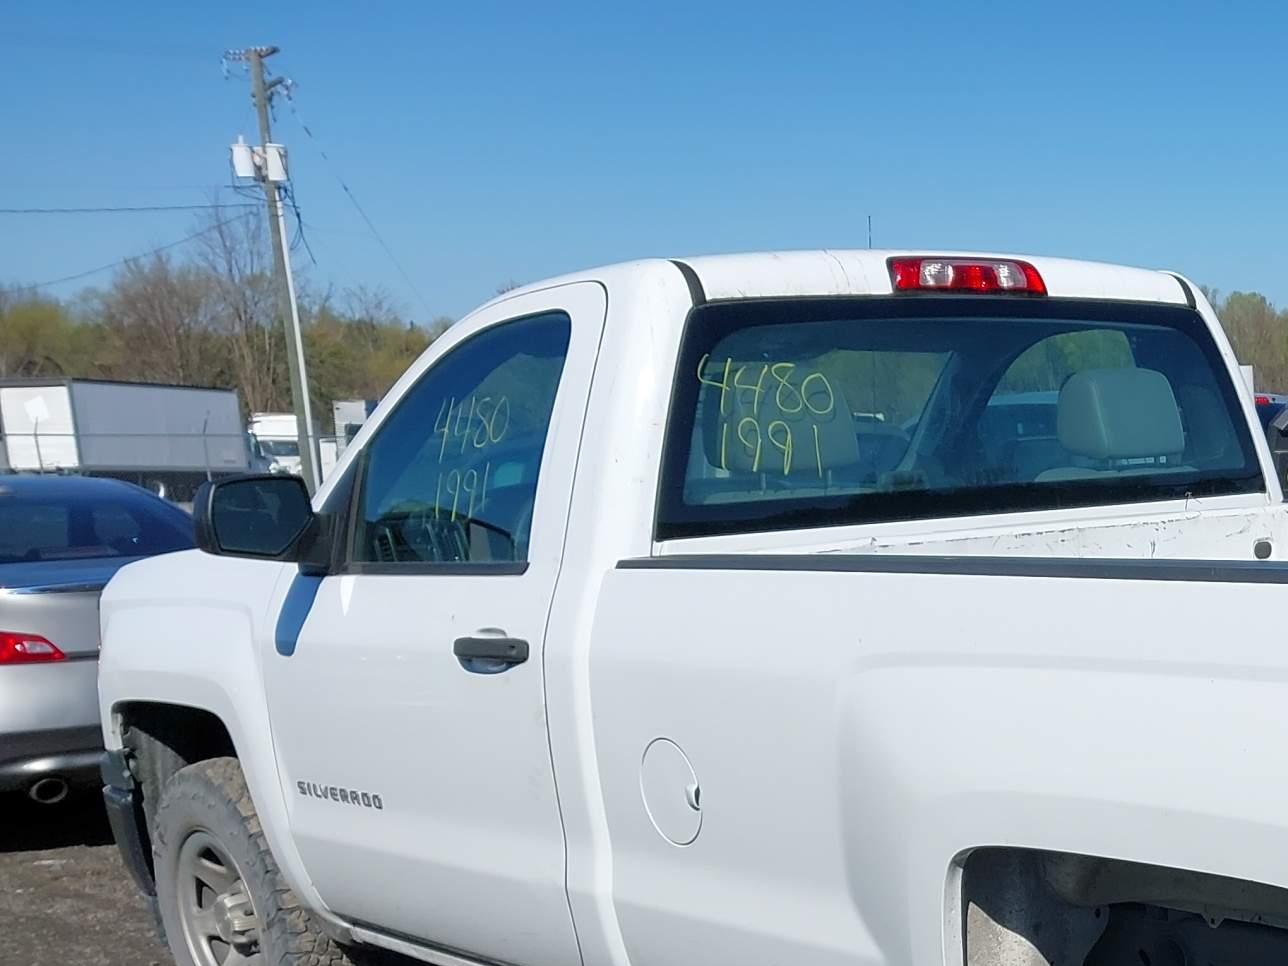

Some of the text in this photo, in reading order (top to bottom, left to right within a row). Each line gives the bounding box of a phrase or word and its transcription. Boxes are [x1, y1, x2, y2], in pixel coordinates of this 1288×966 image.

[697, 353, 834, 415] 4480
[434, 395, 510, 464] 4480
[720, 417, 822, 477] 1991
[435, 461, 490, 522] 1991
[296, 780, 383, 810] SILVERADO
